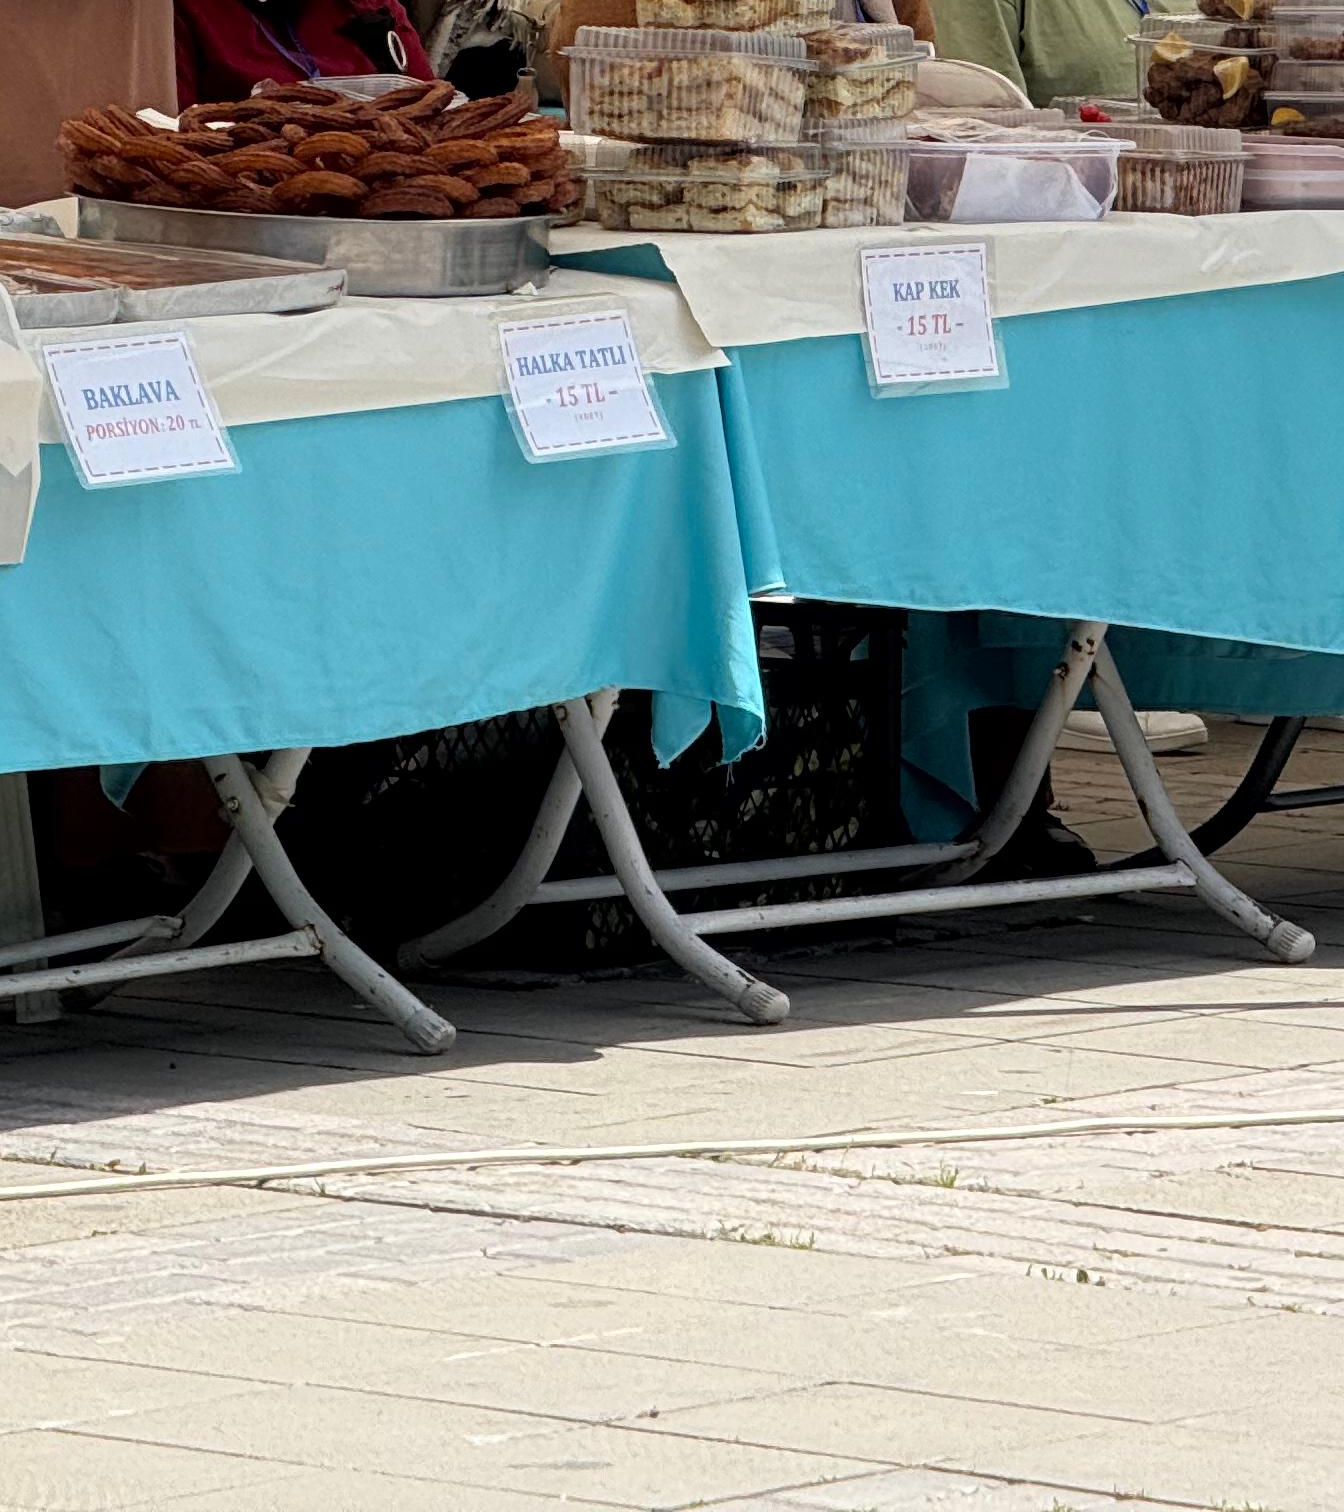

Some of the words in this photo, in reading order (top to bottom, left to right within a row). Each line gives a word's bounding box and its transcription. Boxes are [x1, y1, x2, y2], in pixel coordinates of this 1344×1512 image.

[893, 282, 924, 303] KAP
[928, 279, 960, 299] KEK
[907, 316, 927, 336] 15
[931, 313, 952, 334] TL
[515, 351, 576, 377] HALKA
[575, 345, 627, 369] TATLI
[81, 379, 181, 410] BAKLAVA
[556, 385, 578, 408] 15
[580, 382, 605, 404] TL
[167, 414, 185, 432] 20
